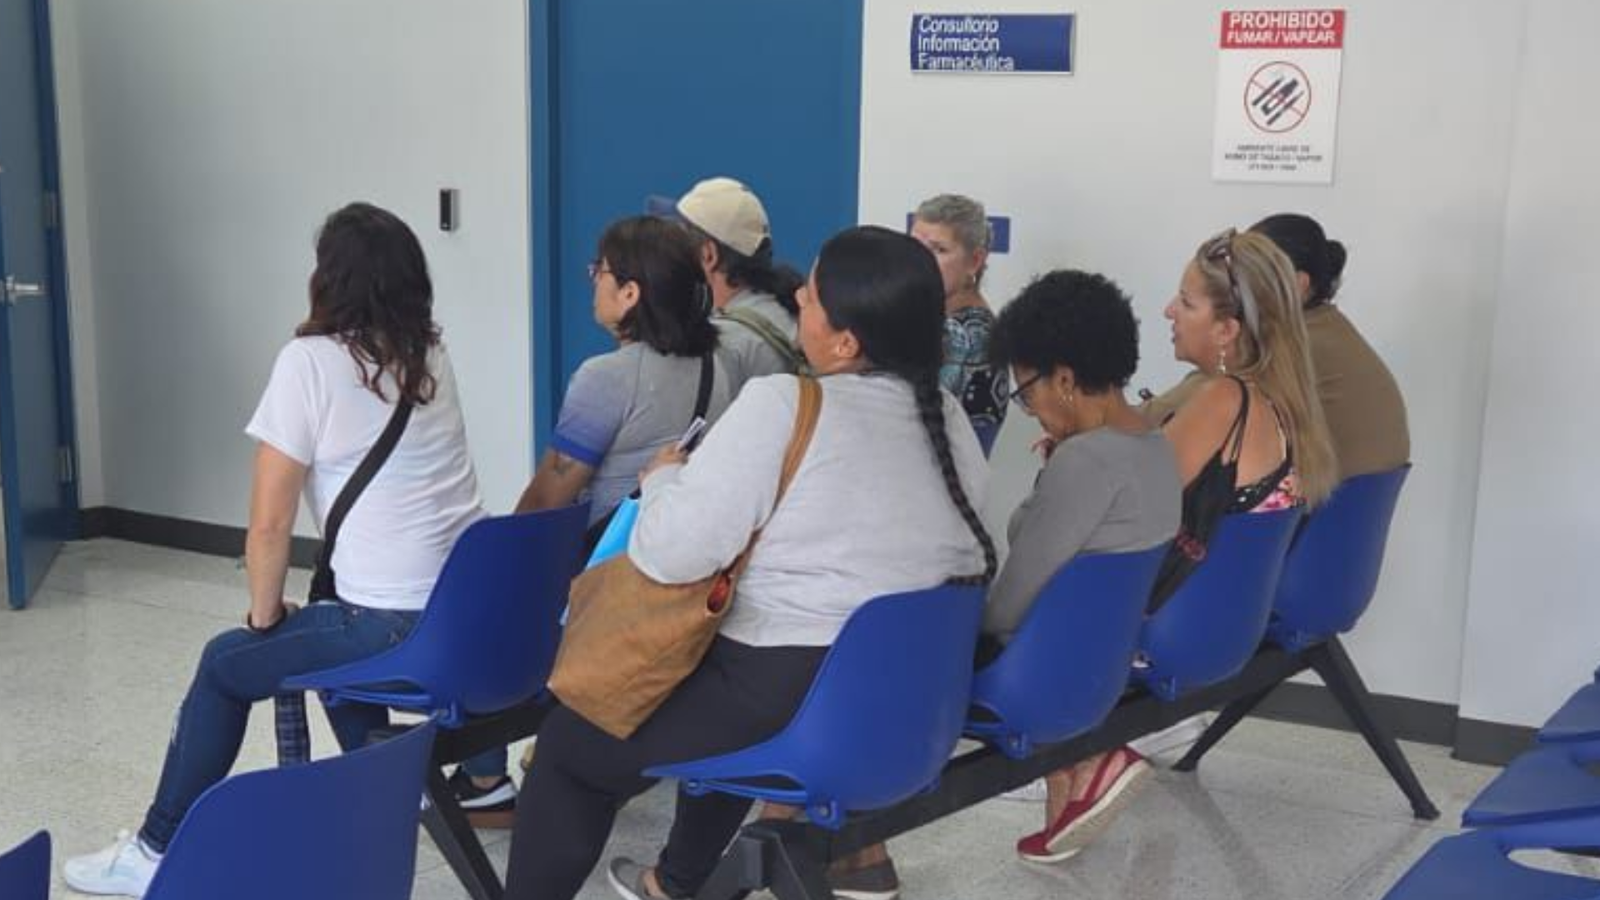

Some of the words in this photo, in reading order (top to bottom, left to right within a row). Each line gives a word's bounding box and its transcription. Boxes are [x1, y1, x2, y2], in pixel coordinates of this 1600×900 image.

[919, 16, 999, 32] Consultorio
[1229, 12, 1335, 29] PROHIBIDO
[918, 35, 1000, 51] Información
[1226, 31, 1272, 43] FUMAR
[1282, 30, 1335, 43] VAPEAR
[918, 53, 1015, 71] Farmacéutica
